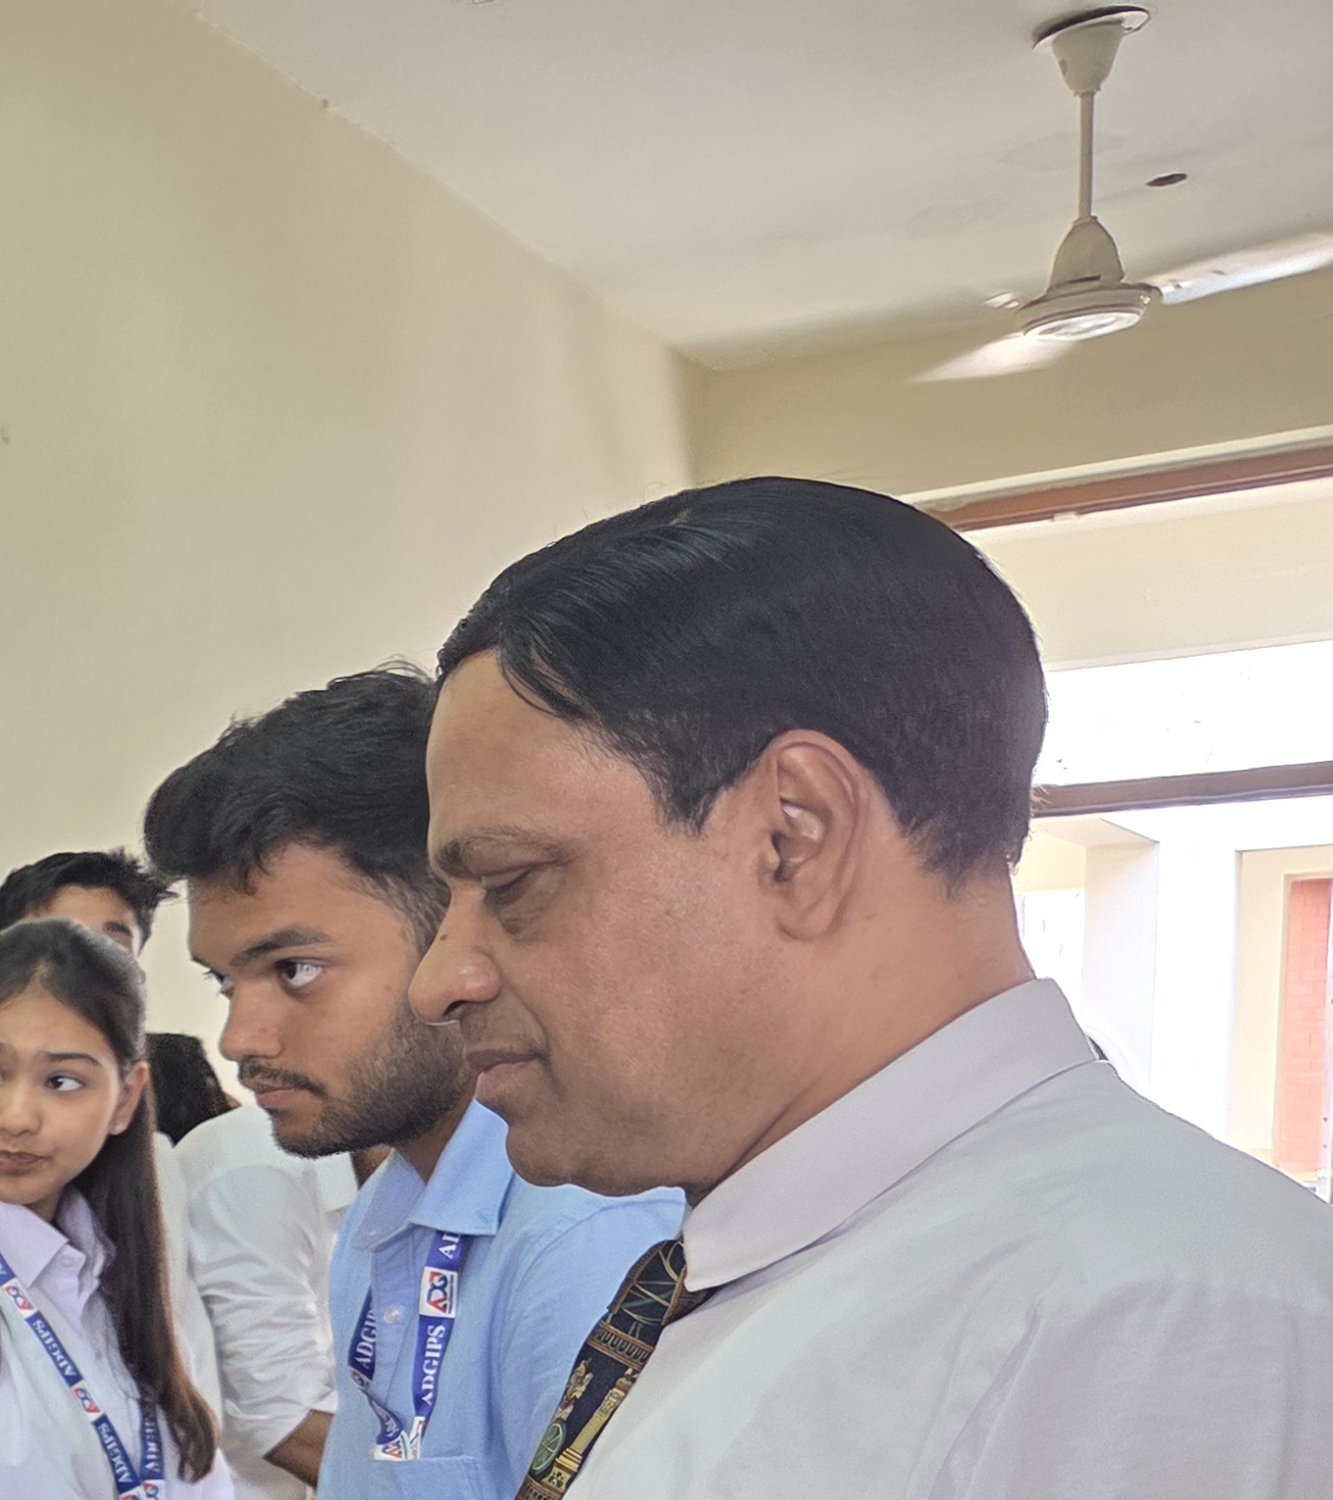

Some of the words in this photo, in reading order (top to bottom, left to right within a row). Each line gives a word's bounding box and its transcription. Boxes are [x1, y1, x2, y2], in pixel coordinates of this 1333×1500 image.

[33, 1319, 77, 1377] ADGIPS
[421, 1324, 446, 1406] ADGIPS
[99, 1422, 133, 1484] ADGIPS
